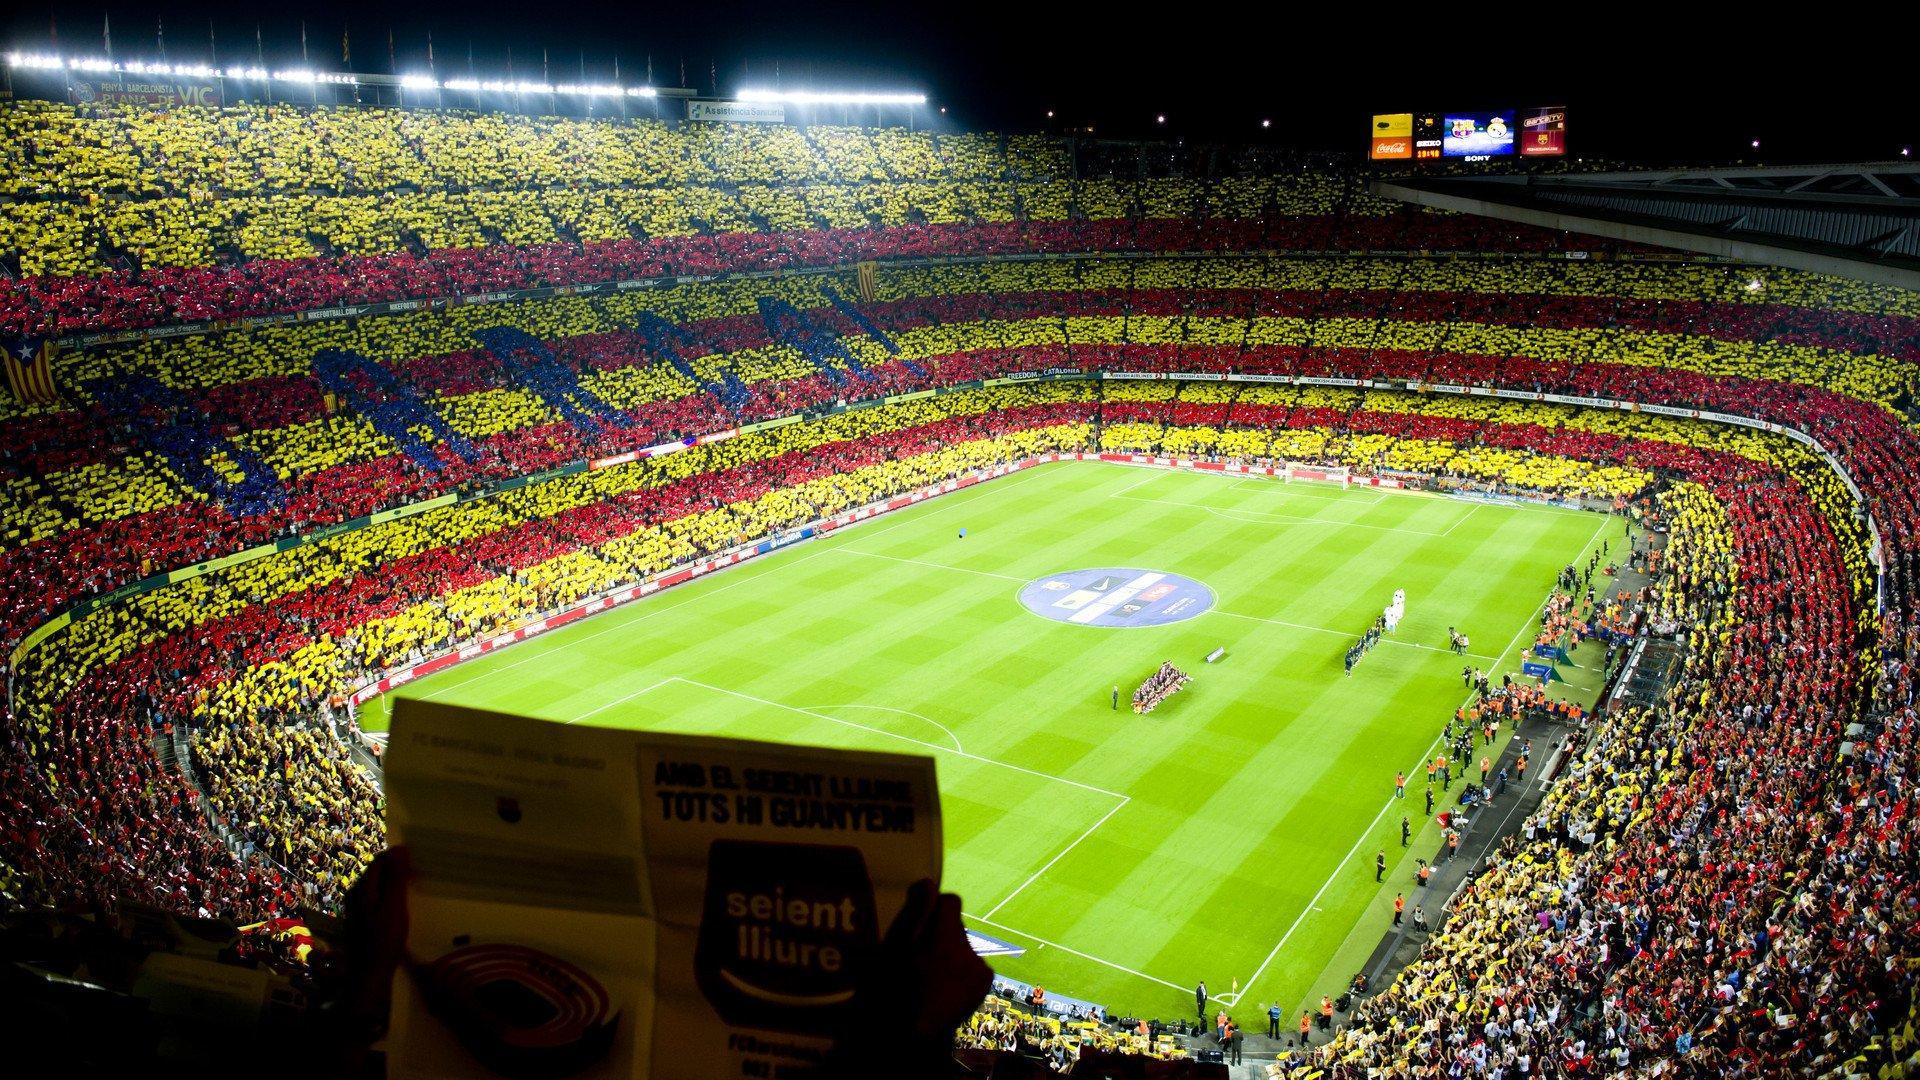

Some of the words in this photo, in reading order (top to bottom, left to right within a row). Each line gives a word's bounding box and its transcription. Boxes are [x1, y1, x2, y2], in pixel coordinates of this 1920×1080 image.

[102, 83, 123, 92] PENYA
[128, 83, 173, 94] BARCELONISTA
[103, 94, 147, 104] PLANA
[158, 96, 174, 105] DE
[177, 85, 214, 105] VIC
[308, 308, 357, 318] NIKEFOOTBALL.COM
[148, 325, 174, 335] Botigues
[1008, 371, 1037, 380] FREEDOM
[1043, 368, 1080, 376] CATALONIA
[1662, 407, 1688, 415] AIRLINES
[1715, 414, 1739, 423] TURKISH
[1740, 418, 1762, 427] AIRLINES
[101, 594, 113, 604] Qatar
[113, 585, 141, 601] Foundation
[655, 761, 706, 788] AMB
[710, 765, 739, 791] EL
[744, 768, 823, 797] SEIENT
[830, 777, 914, 804] LLIURE
[658, 791, 730, 823] TOTS
[736, 795, 763, 826] HI
[725, 884, 856, 934] seient
[738, 924, 843, 975] lliure
